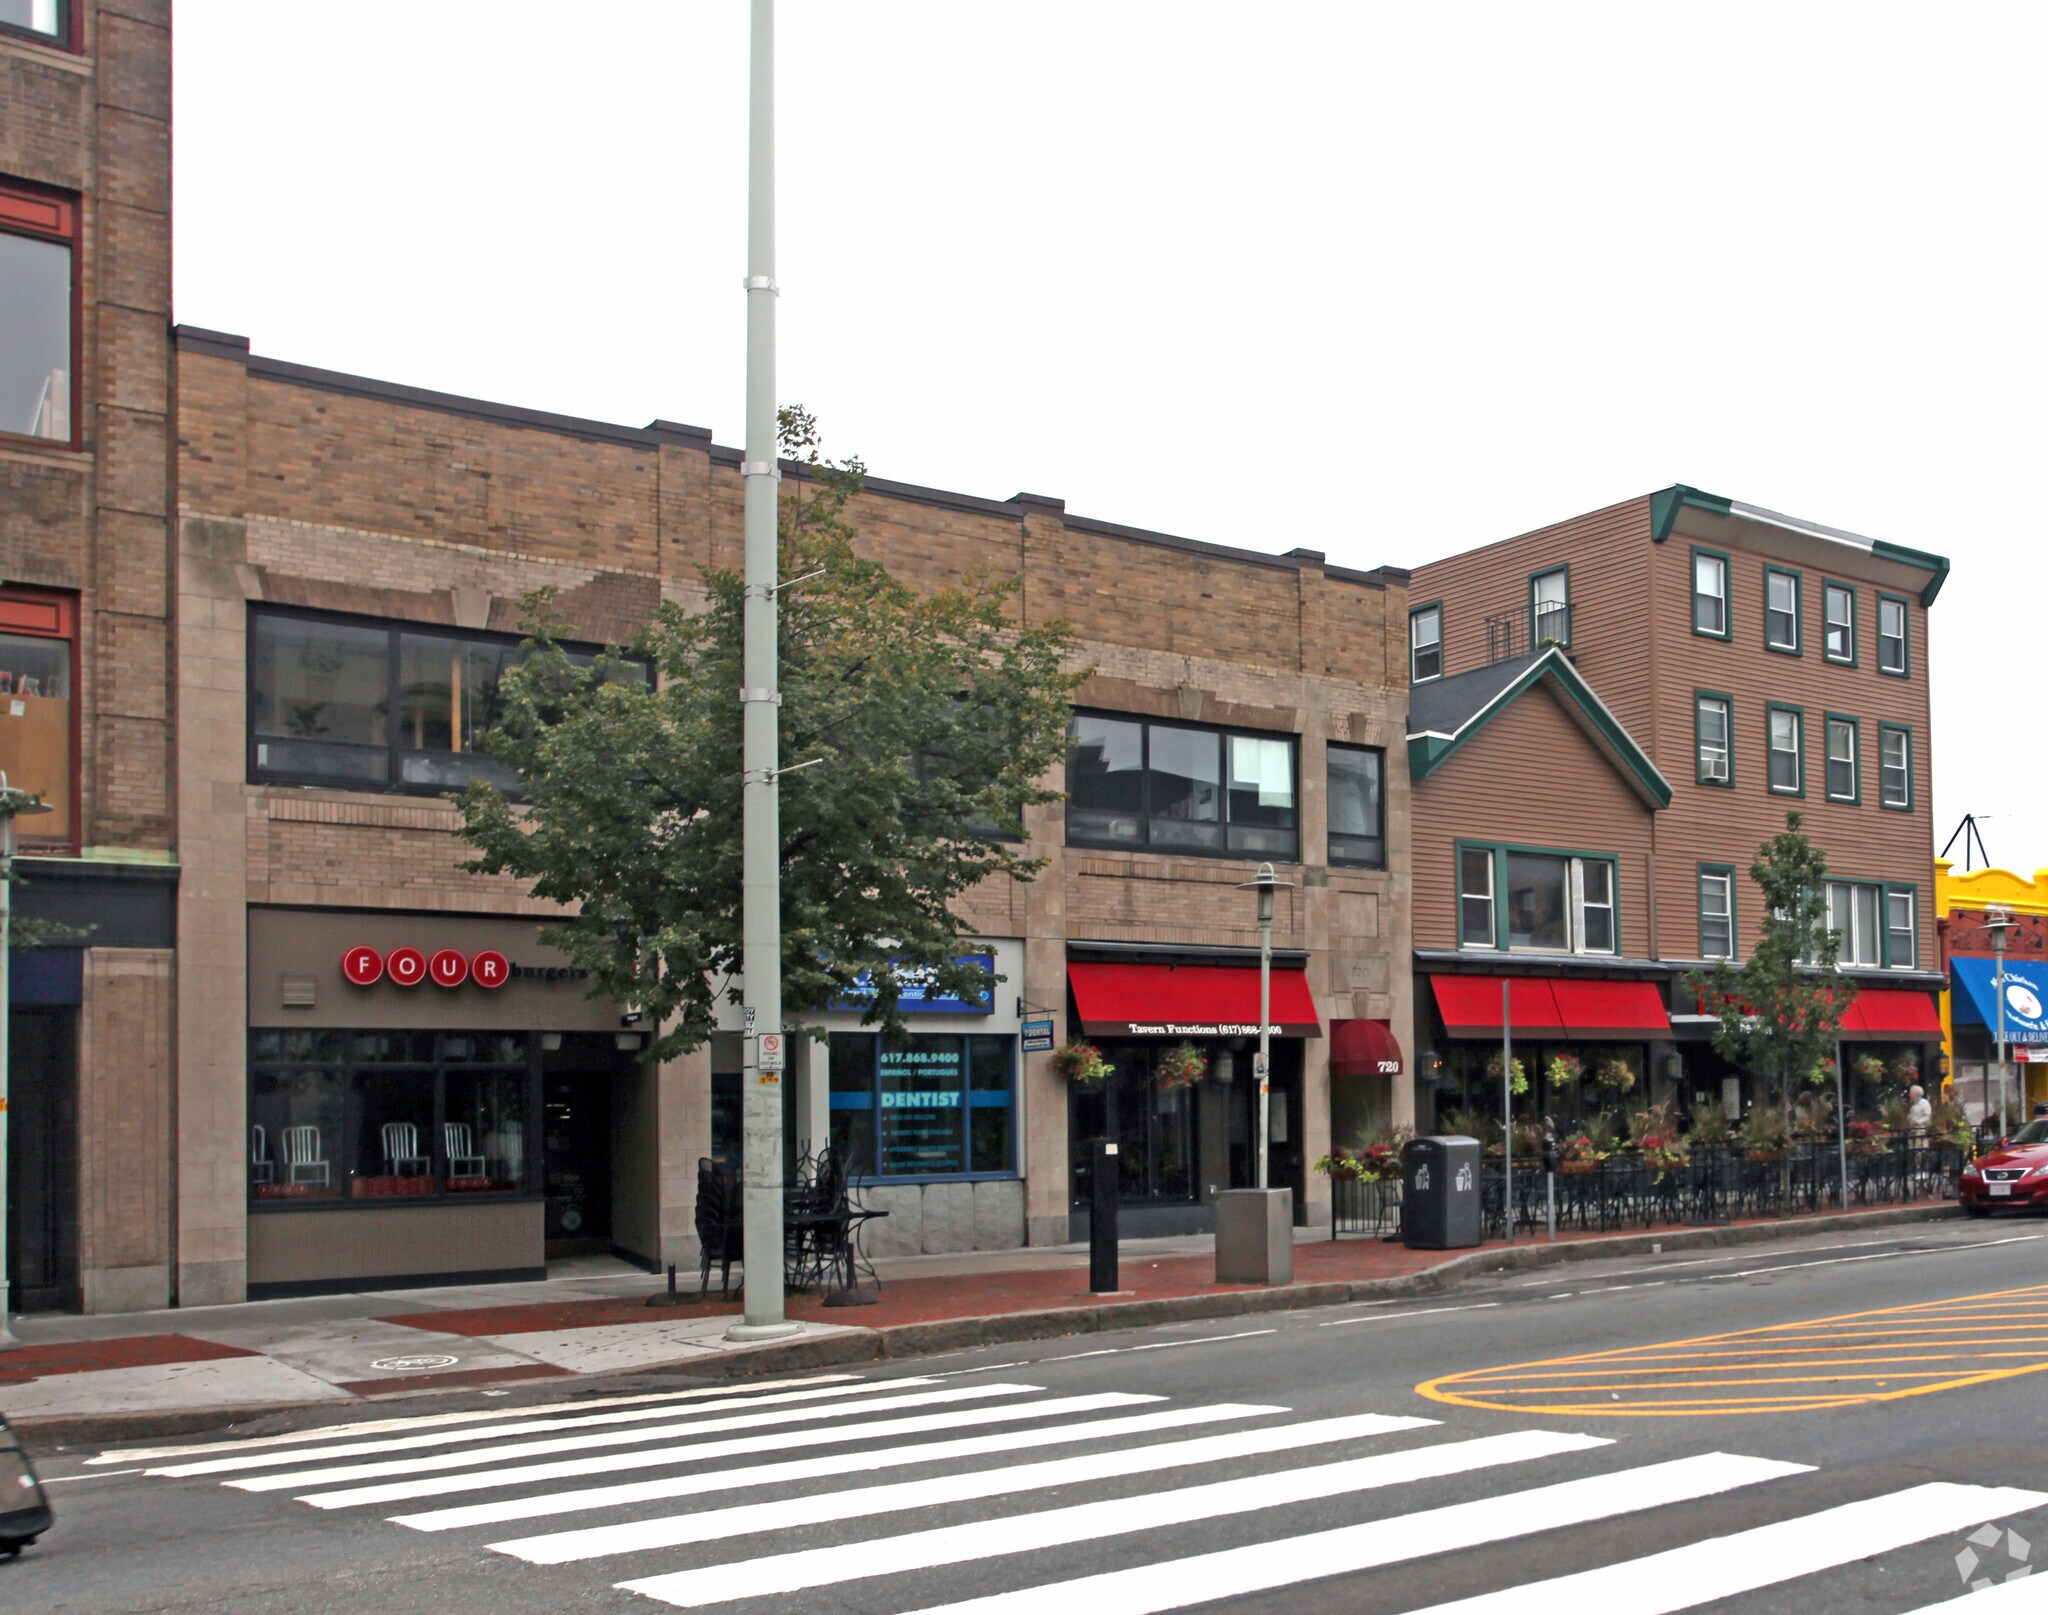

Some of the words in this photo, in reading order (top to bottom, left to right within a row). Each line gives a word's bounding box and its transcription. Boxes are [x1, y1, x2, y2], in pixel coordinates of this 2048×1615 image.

[359, 956, 496, 977] FOUR
[510, 962, 589, 982] burgers
[1352, 966, 1368, 977] 720
[1129, 1023, 1165, 1033] Tavern
[1167, 1024, 1217, 1034] Functions
[1242, 1025, 1282, 1035] 868-00
[880, 1052, 959, 1063] 617.868.9400
[1377, 1061, 1399, 1072] 720
[881, 1092, 960, 1107] DENTIST
